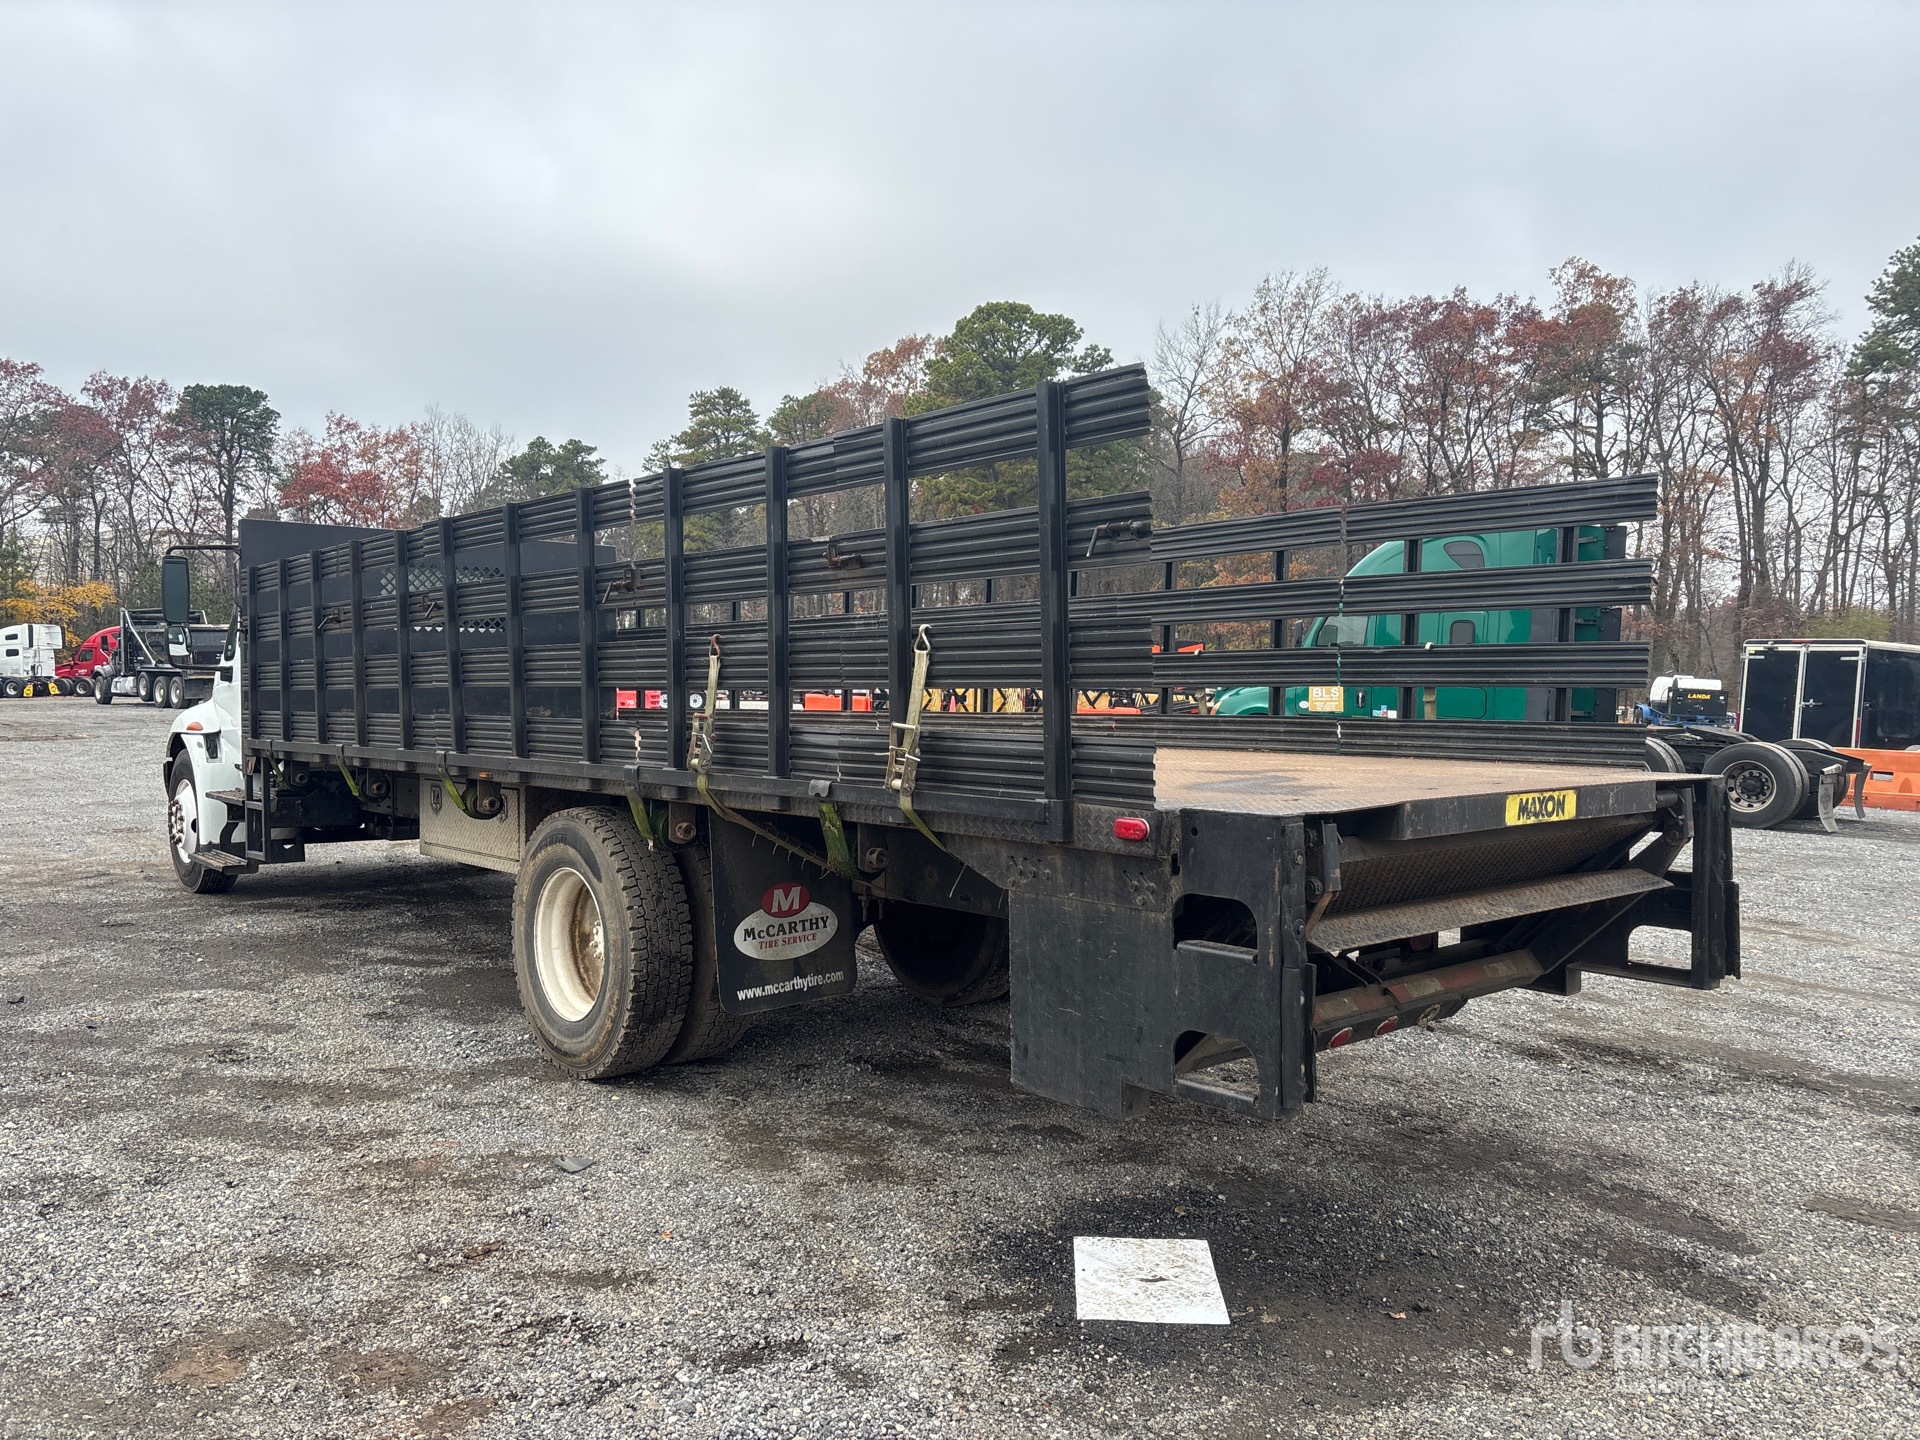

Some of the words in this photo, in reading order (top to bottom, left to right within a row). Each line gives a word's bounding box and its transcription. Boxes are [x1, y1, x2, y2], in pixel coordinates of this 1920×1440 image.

[1313, 687, 1339, 697] BLS
[1517, 794, 1566, 821] MAXON
[771, 886, 801, 913] M
[743, 915, 830, 942] McCARTHY
[758, 939, 779, 950] TIRE
[782, 932, 817, 947] SERVICE
[737, 970, 844, 1001] www.mccarthytire.com
